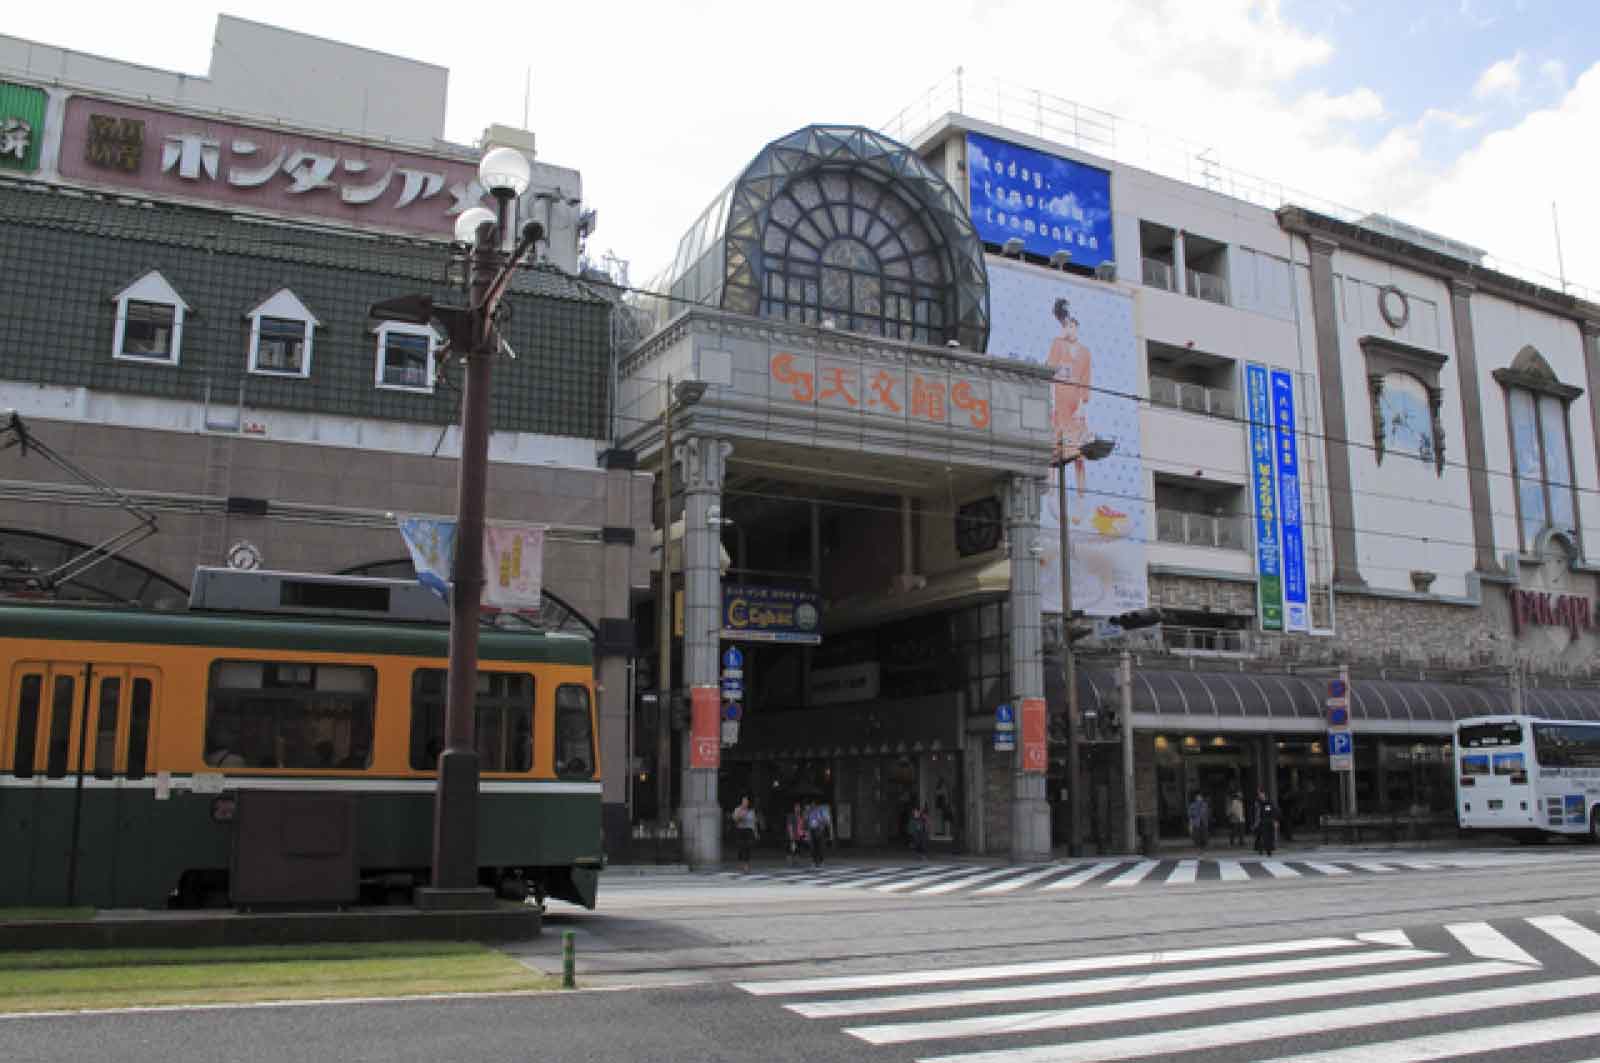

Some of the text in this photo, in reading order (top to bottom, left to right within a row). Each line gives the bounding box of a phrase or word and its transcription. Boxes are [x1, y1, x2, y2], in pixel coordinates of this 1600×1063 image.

[818, 367, 946, 422] 天文館
[1334, 734, 1347, 754] P
